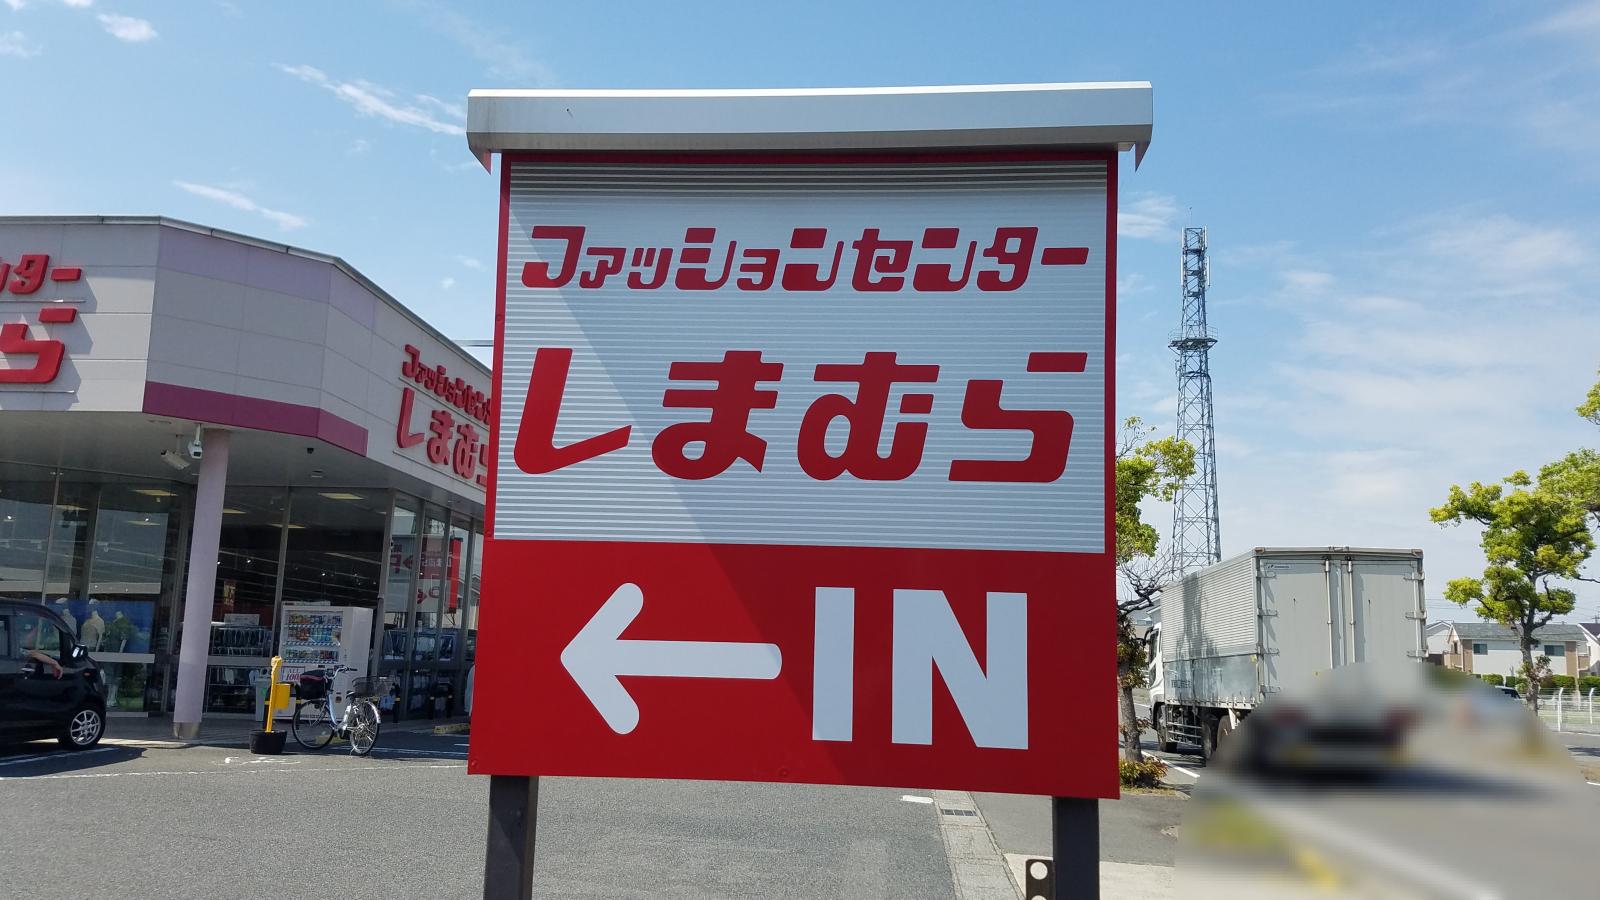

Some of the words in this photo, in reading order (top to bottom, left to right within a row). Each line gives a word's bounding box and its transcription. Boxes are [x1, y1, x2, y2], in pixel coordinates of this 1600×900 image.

[521, 225, 1089, 292] ファッションセンター
[513, 348, 1089, 483] しまむら
[812, 586, 1029, 750] IN
